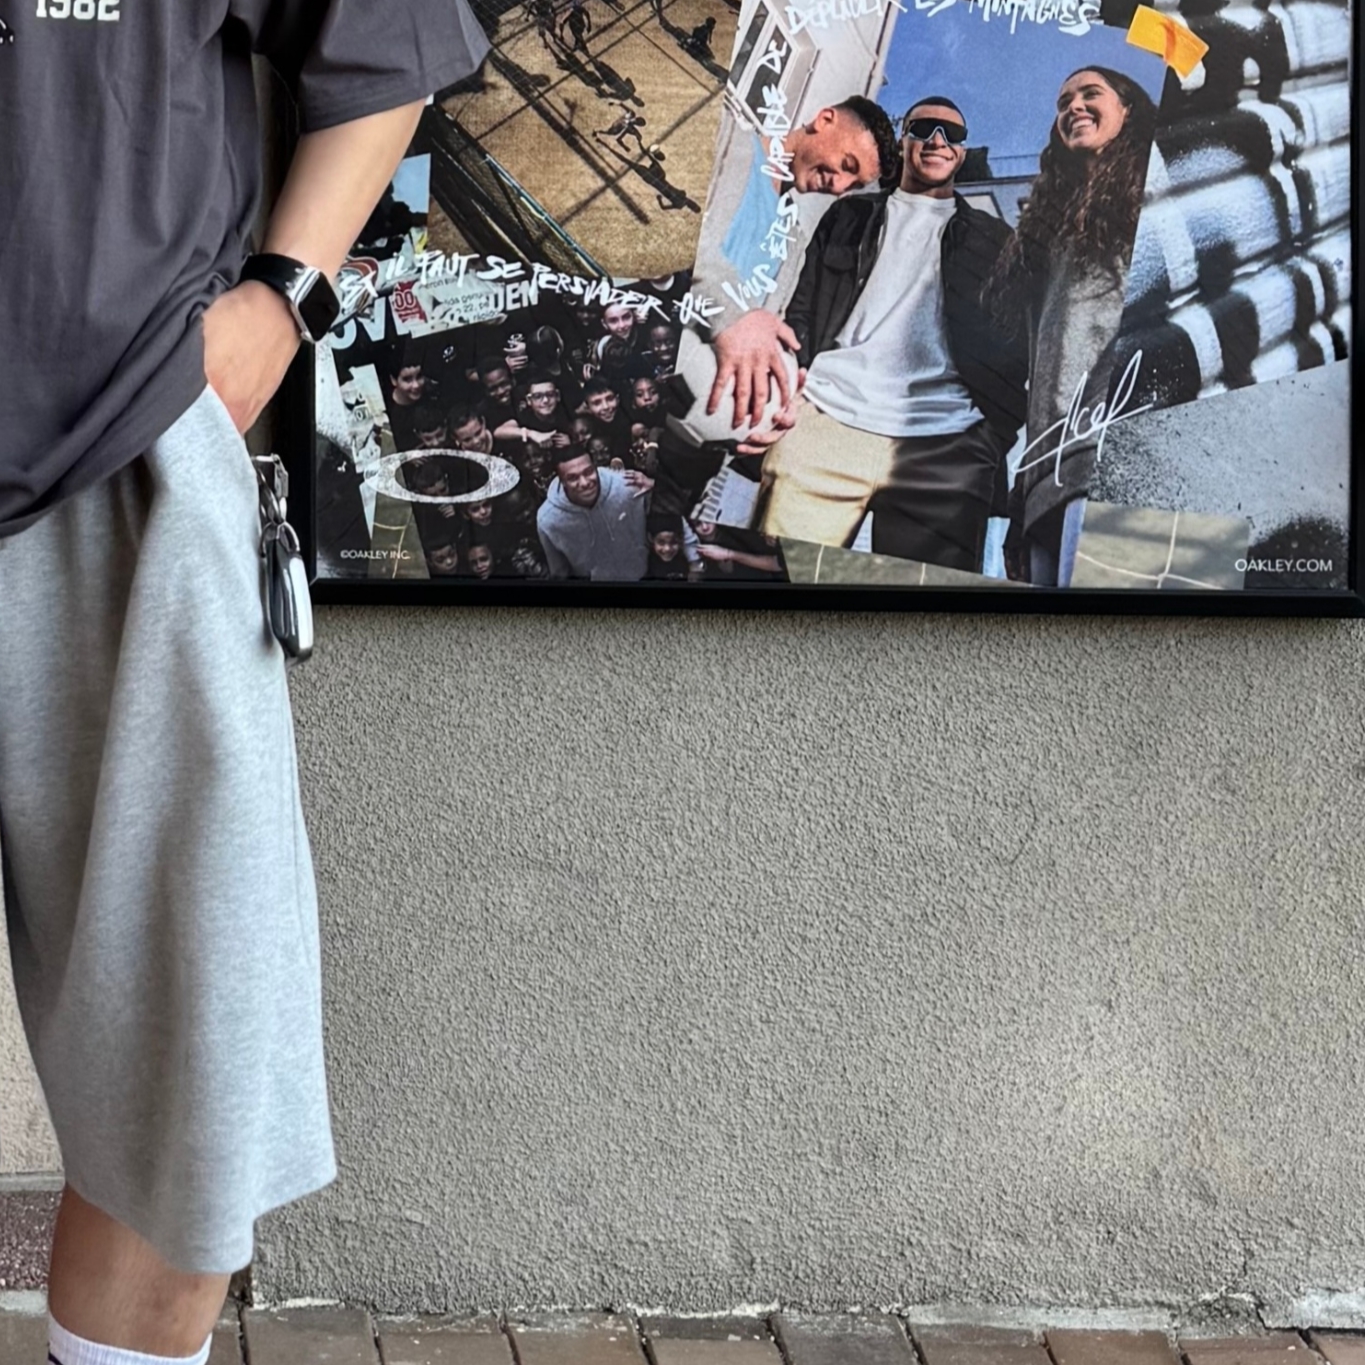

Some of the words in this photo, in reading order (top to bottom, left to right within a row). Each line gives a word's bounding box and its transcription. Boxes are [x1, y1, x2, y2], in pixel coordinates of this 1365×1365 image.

[413, 249, 480, 288] FAUT
[476, 255, 525, 280] SE
[1234, 558, 1333, 572] OAKLEY.COM
